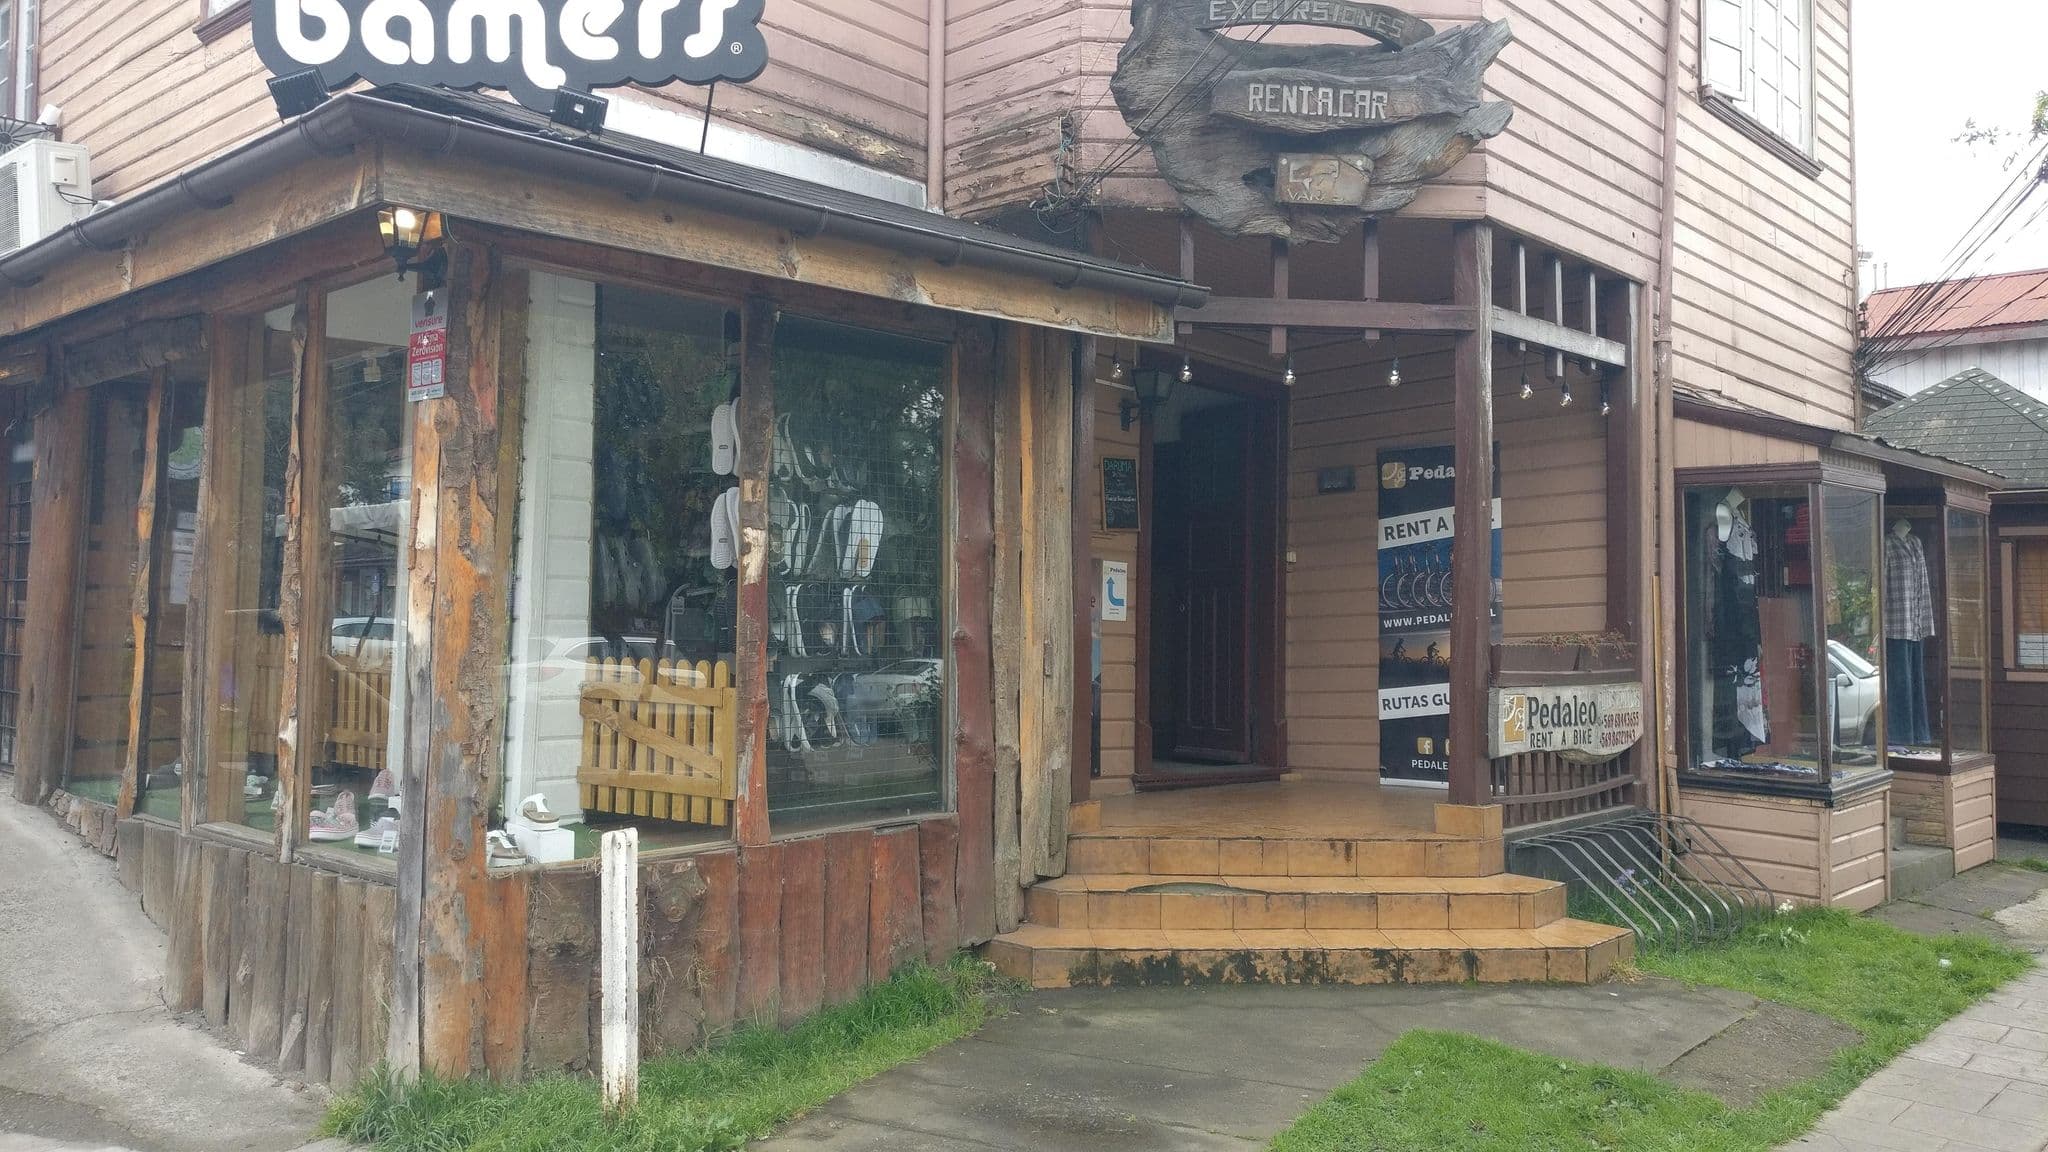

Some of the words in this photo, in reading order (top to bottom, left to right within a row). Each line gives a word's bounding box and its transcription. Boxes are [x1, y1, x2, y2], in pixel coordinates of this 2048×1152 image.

[1209, 0, 1404, 38] EXCURSIONES
[276, 0, 740, 89] bamers
[1408, 464, 1456, 480] Peda
[1384, 518, 1431, 541] RENT
[1436, 516, 1449, 532] A
[1382, 694, 1429, 711] RUTAS
[1527, 695, 1597, 730] Pedaleo
[1530, 731, 1554, 748] RENT
[1561, 731, 1567, 745] A
[1573, 729, 1593, 745] BIKE
[1411, 759, 1449, 771] PEDALE
